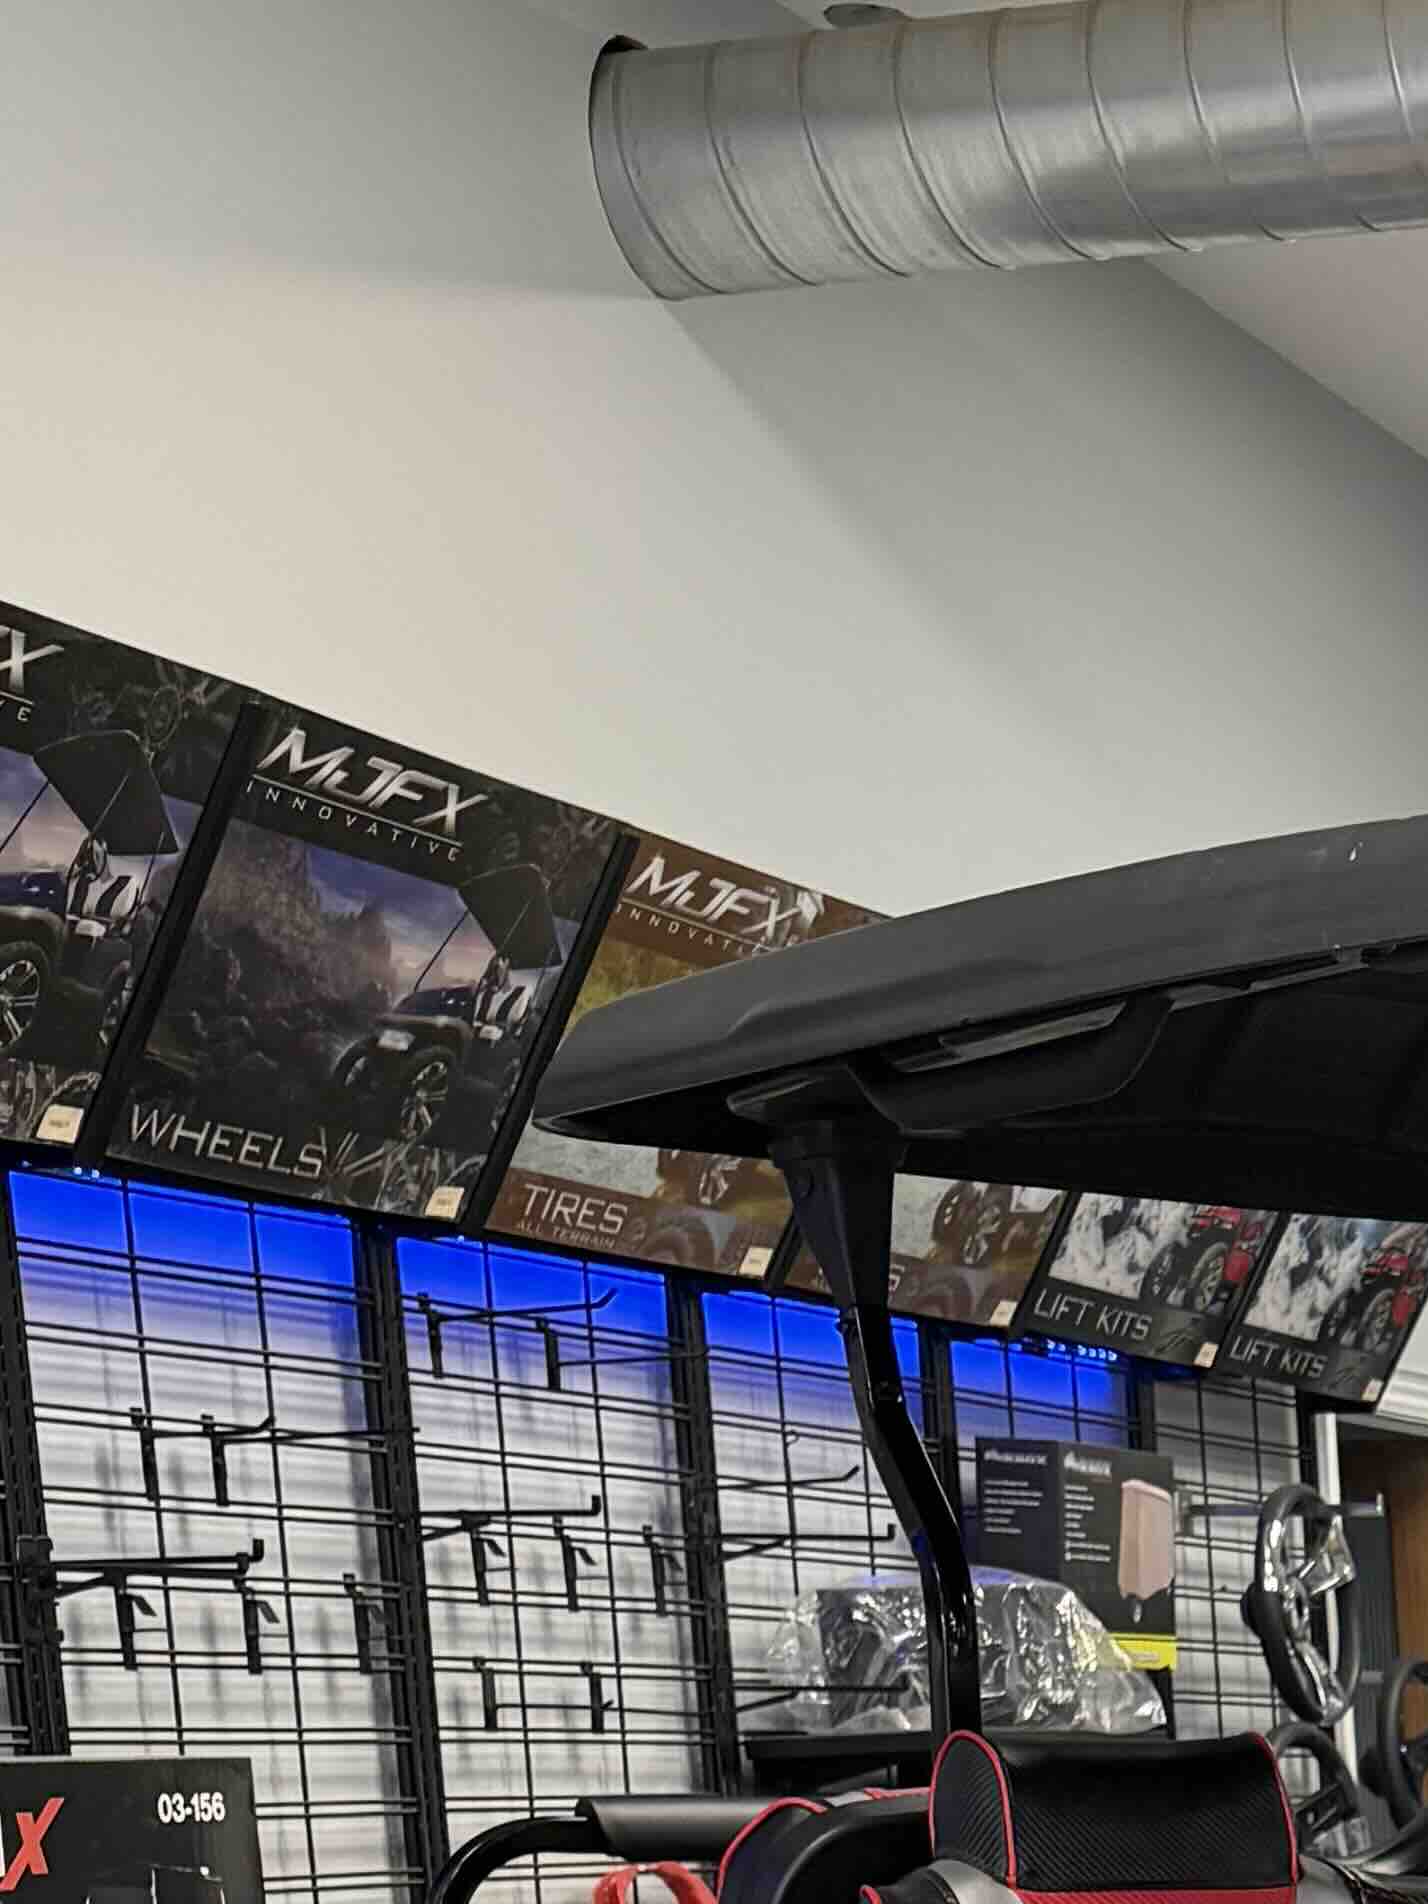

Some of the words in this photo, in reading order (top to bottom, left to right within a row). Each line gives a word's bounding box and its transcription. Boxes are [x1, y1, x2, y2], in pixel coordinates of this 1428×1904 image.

[256, 726, 488, 834] MJFX
[246, 779, 461, 863] INNOVATIVE
[623, 855, 800, 938] MJFX
[128, 1103, 324, 1178] WHEELS
[524, 1183, 628, 1235] TIRES
[1033, 1287, 1094, 1327] LIFT
[1095, 1302, 1153, 1341] KITS
[1230, 1334, 1278, 1367] LIFT
[1279, 1346, 1329, 1379] KITS
[157, 1792, 225, 1824] 03-156
